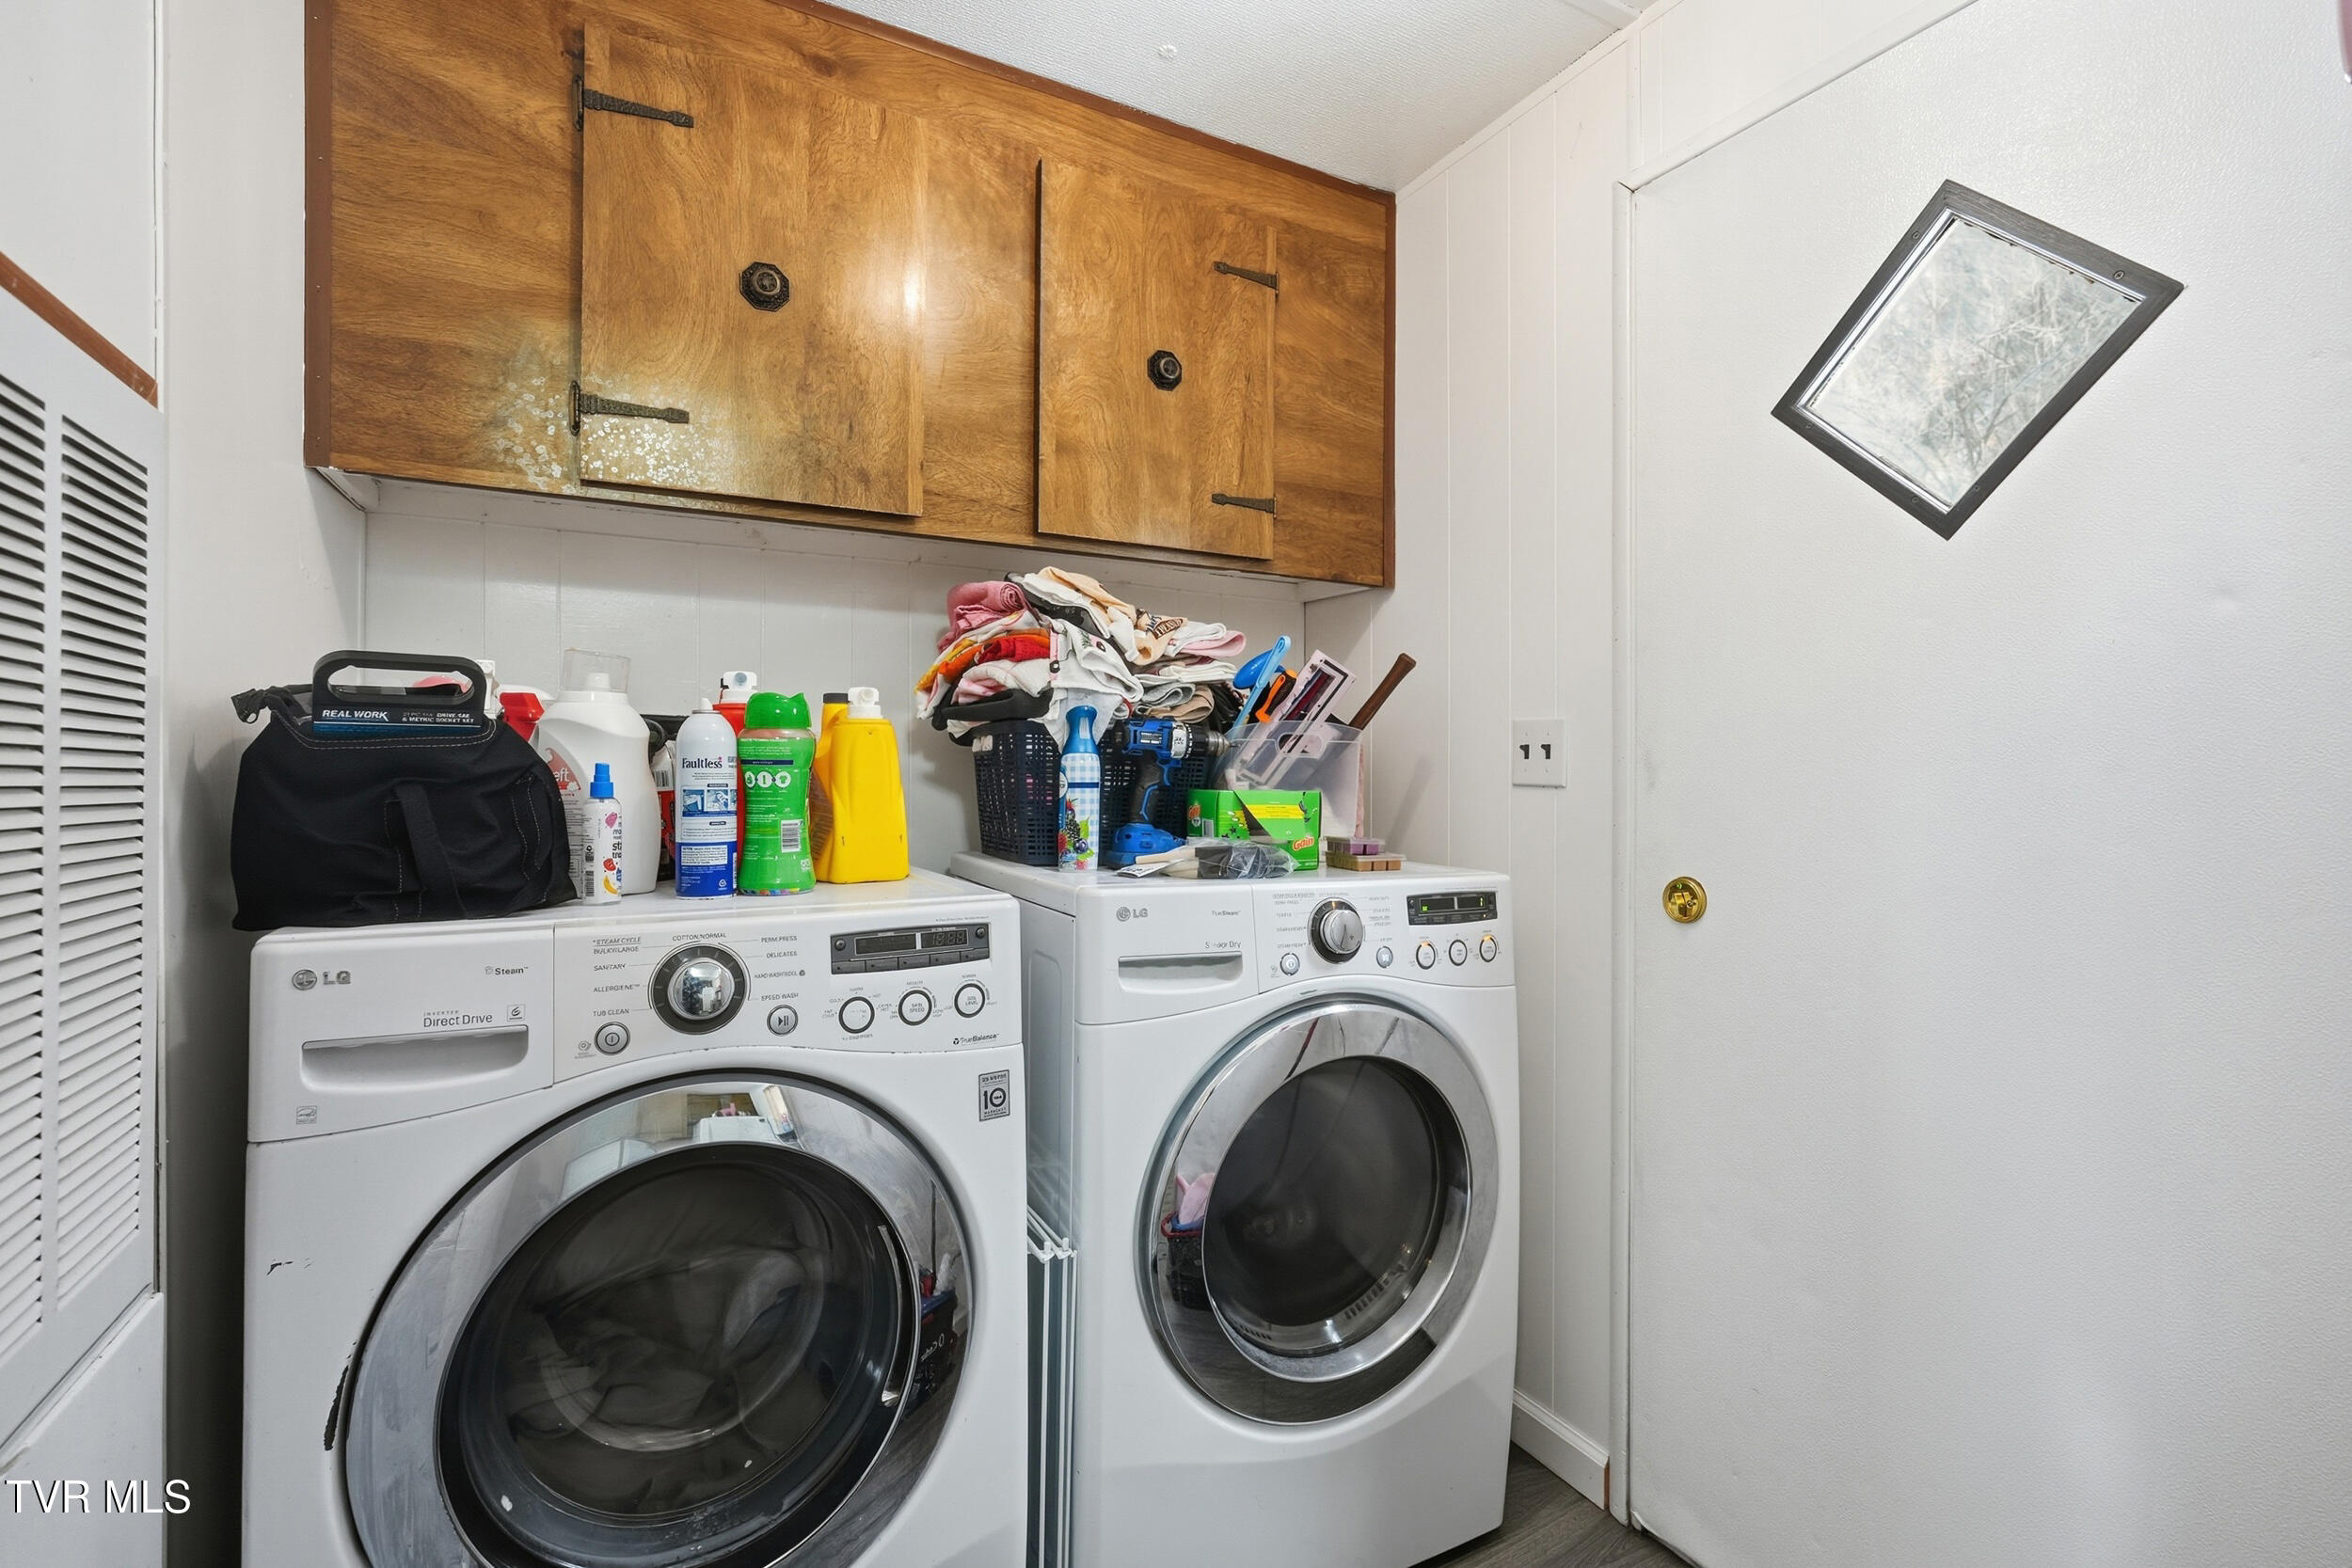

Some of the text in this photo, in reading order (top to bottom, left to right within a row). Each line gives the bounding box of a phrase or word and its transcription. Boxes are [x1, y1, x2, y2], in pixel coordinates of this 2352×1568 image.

[322, 709, 389, 721] REAL WORK
[682, 756, 723, 768] Faultless
[554, 768, 570, 782] eft
[1293, 836, 1314, 850] Gain
[1132, 908, 1148, 918] LG
[323, 970, 351, 985] LG
[423, 1014, 493, 1027] Direct Drive
[983, 1087, 1007, 1110] 10
